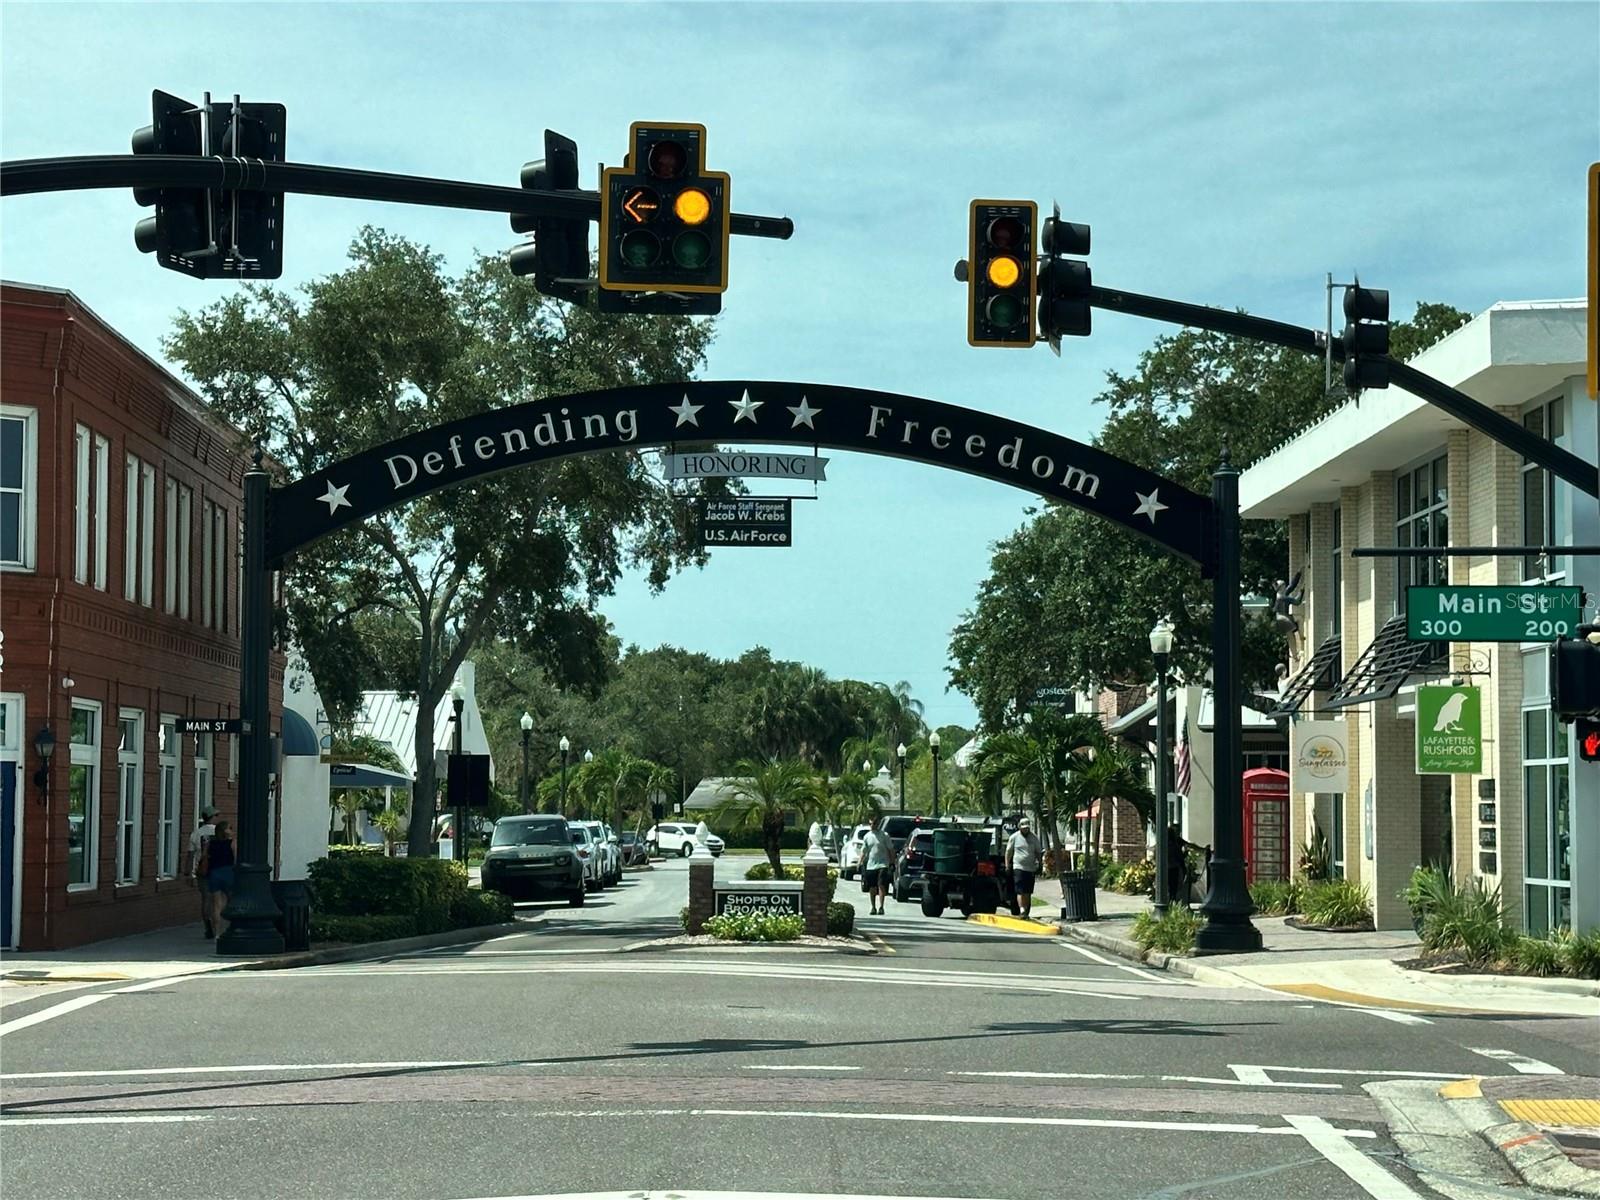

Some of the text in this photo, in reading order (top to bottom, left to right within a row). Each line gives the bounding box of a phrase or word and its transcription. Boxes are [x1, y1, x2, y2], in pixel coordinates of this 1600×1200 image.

[384, 405, 1101, 499] Defending Freedom
[683, 455, 807, 476] HONORING
[706, 502, 785, 513] Air Force Staff Sergeant
[705, 510, 786, 521] Jacob W. Krebs
[704, 529, 729, 542] U.S.
[1438, 593, 1549, 614] Main St
[1420, 619, 1569, 636] 300 200
[186, 721, 227, 731] MAIN ST
[1423, 745, 1477, 756] RUSHFORD
[727, 894, 768, 905] SHOPS
[724, 904, 792, 914] BROADWAY
